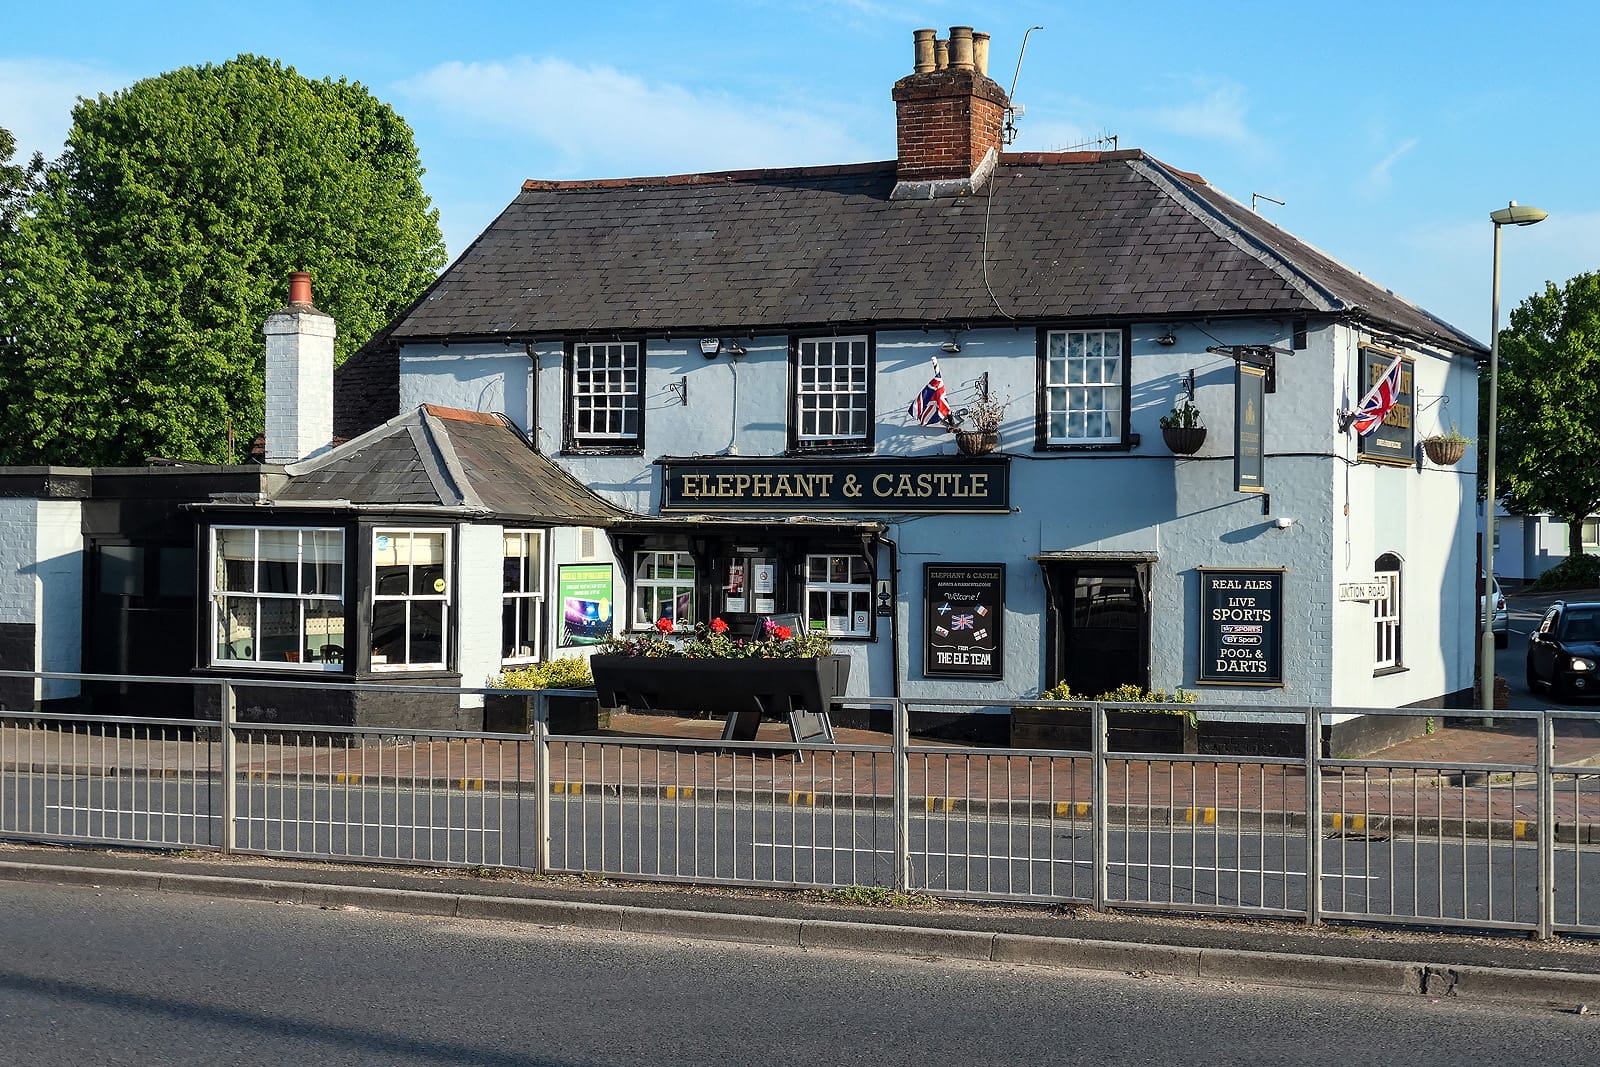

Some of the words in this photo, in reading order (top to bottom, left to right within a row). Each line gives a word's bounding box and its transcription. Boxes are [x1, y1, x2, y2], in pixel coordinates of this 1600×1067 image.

[681, 474, 834, 497] ELEPHANT
[842, 474, 863, 497] &
[872, 474, 988, 497] CASTLE
[1212, 579, 1241, 589] REAL
[1244, 580, 1272, 590] ALES
[944, 592, 980, 601] Welcome!
[1368, 585, 1386, 597] ROAD
[1228, 597, 1255, 607] LIVE
[1212, 608, 1271, 621] SPORTS
[937, 652, 952, 664] THE
[953, 653, 969, 665] ELE
[970, 653, 991, 666] TEAM
[1220, 648, 1252, 658] POOL
[1254, 649, 1263, 659] &
[1216, 660, 1267, 673] DARTS
